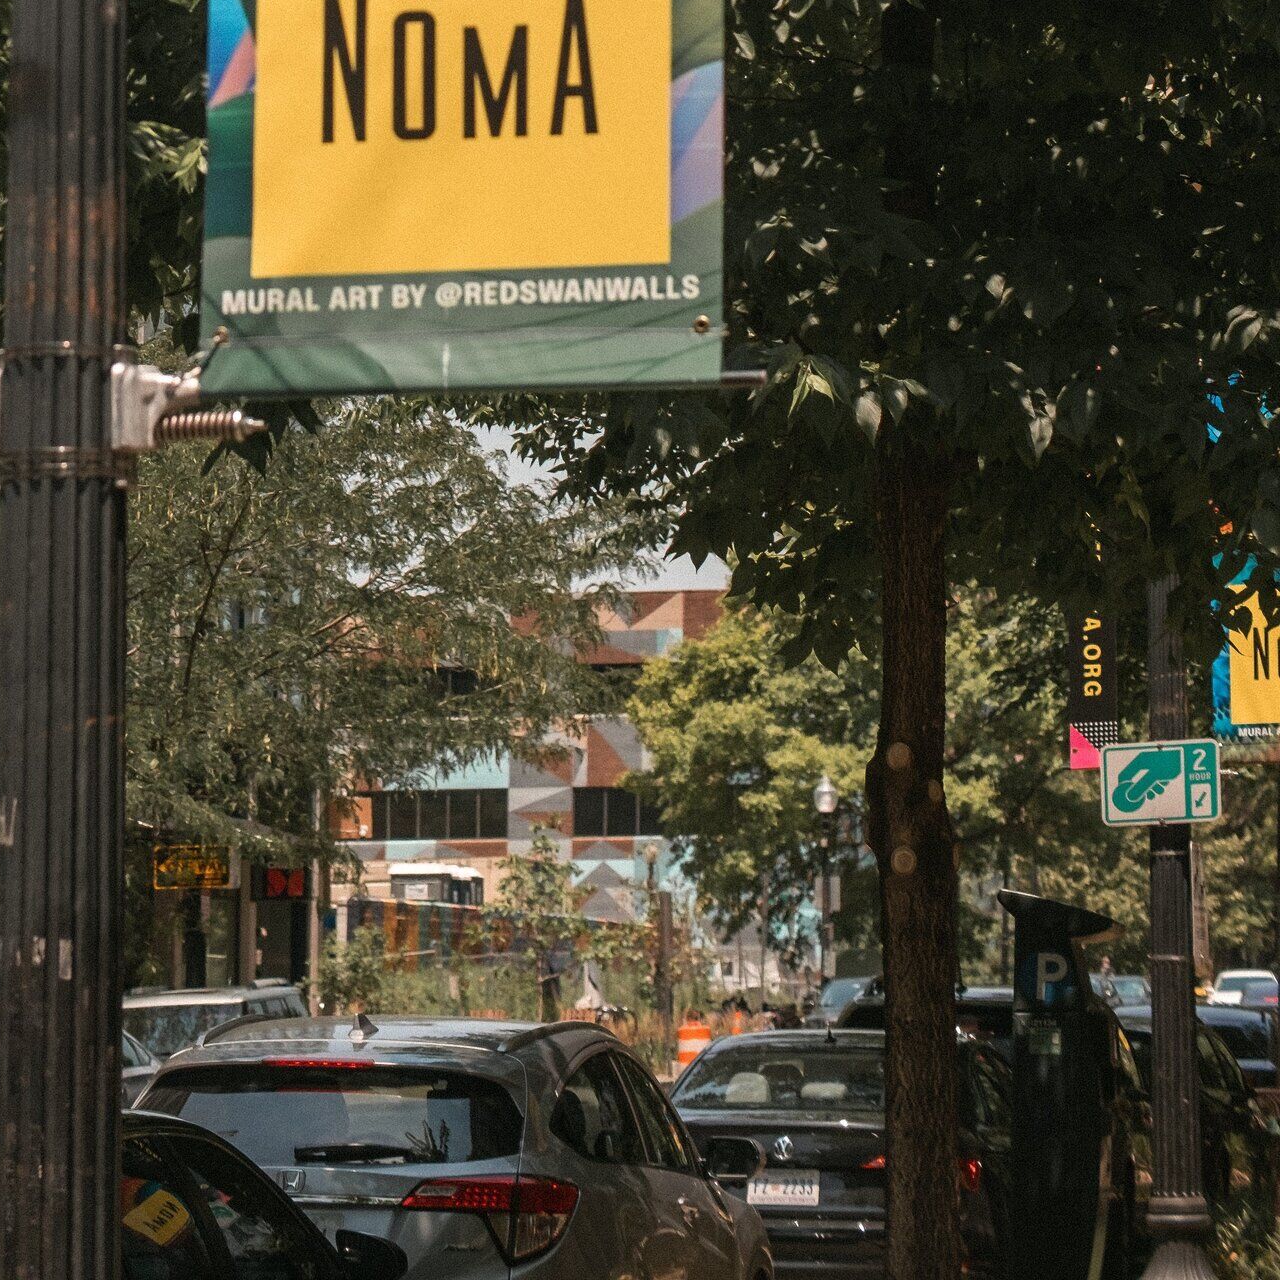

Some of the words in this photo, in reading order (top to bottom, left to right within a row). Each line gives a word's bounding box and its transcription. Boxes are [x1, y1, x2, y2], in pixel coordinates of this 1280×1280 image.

[221, 287, 319, 315] MURAL
[328, 285, 383, 310] ART
[391, 284, 426, 308] BY
[435, 274, 700, 308] @REDSWANWALLS
[1238, 727, 1273, 738] MURAL
[1192, 748, 1207, 771] 2
[1189, 772, 1211, 781] HOUR
[1036, 952, 1068, 1001] P
